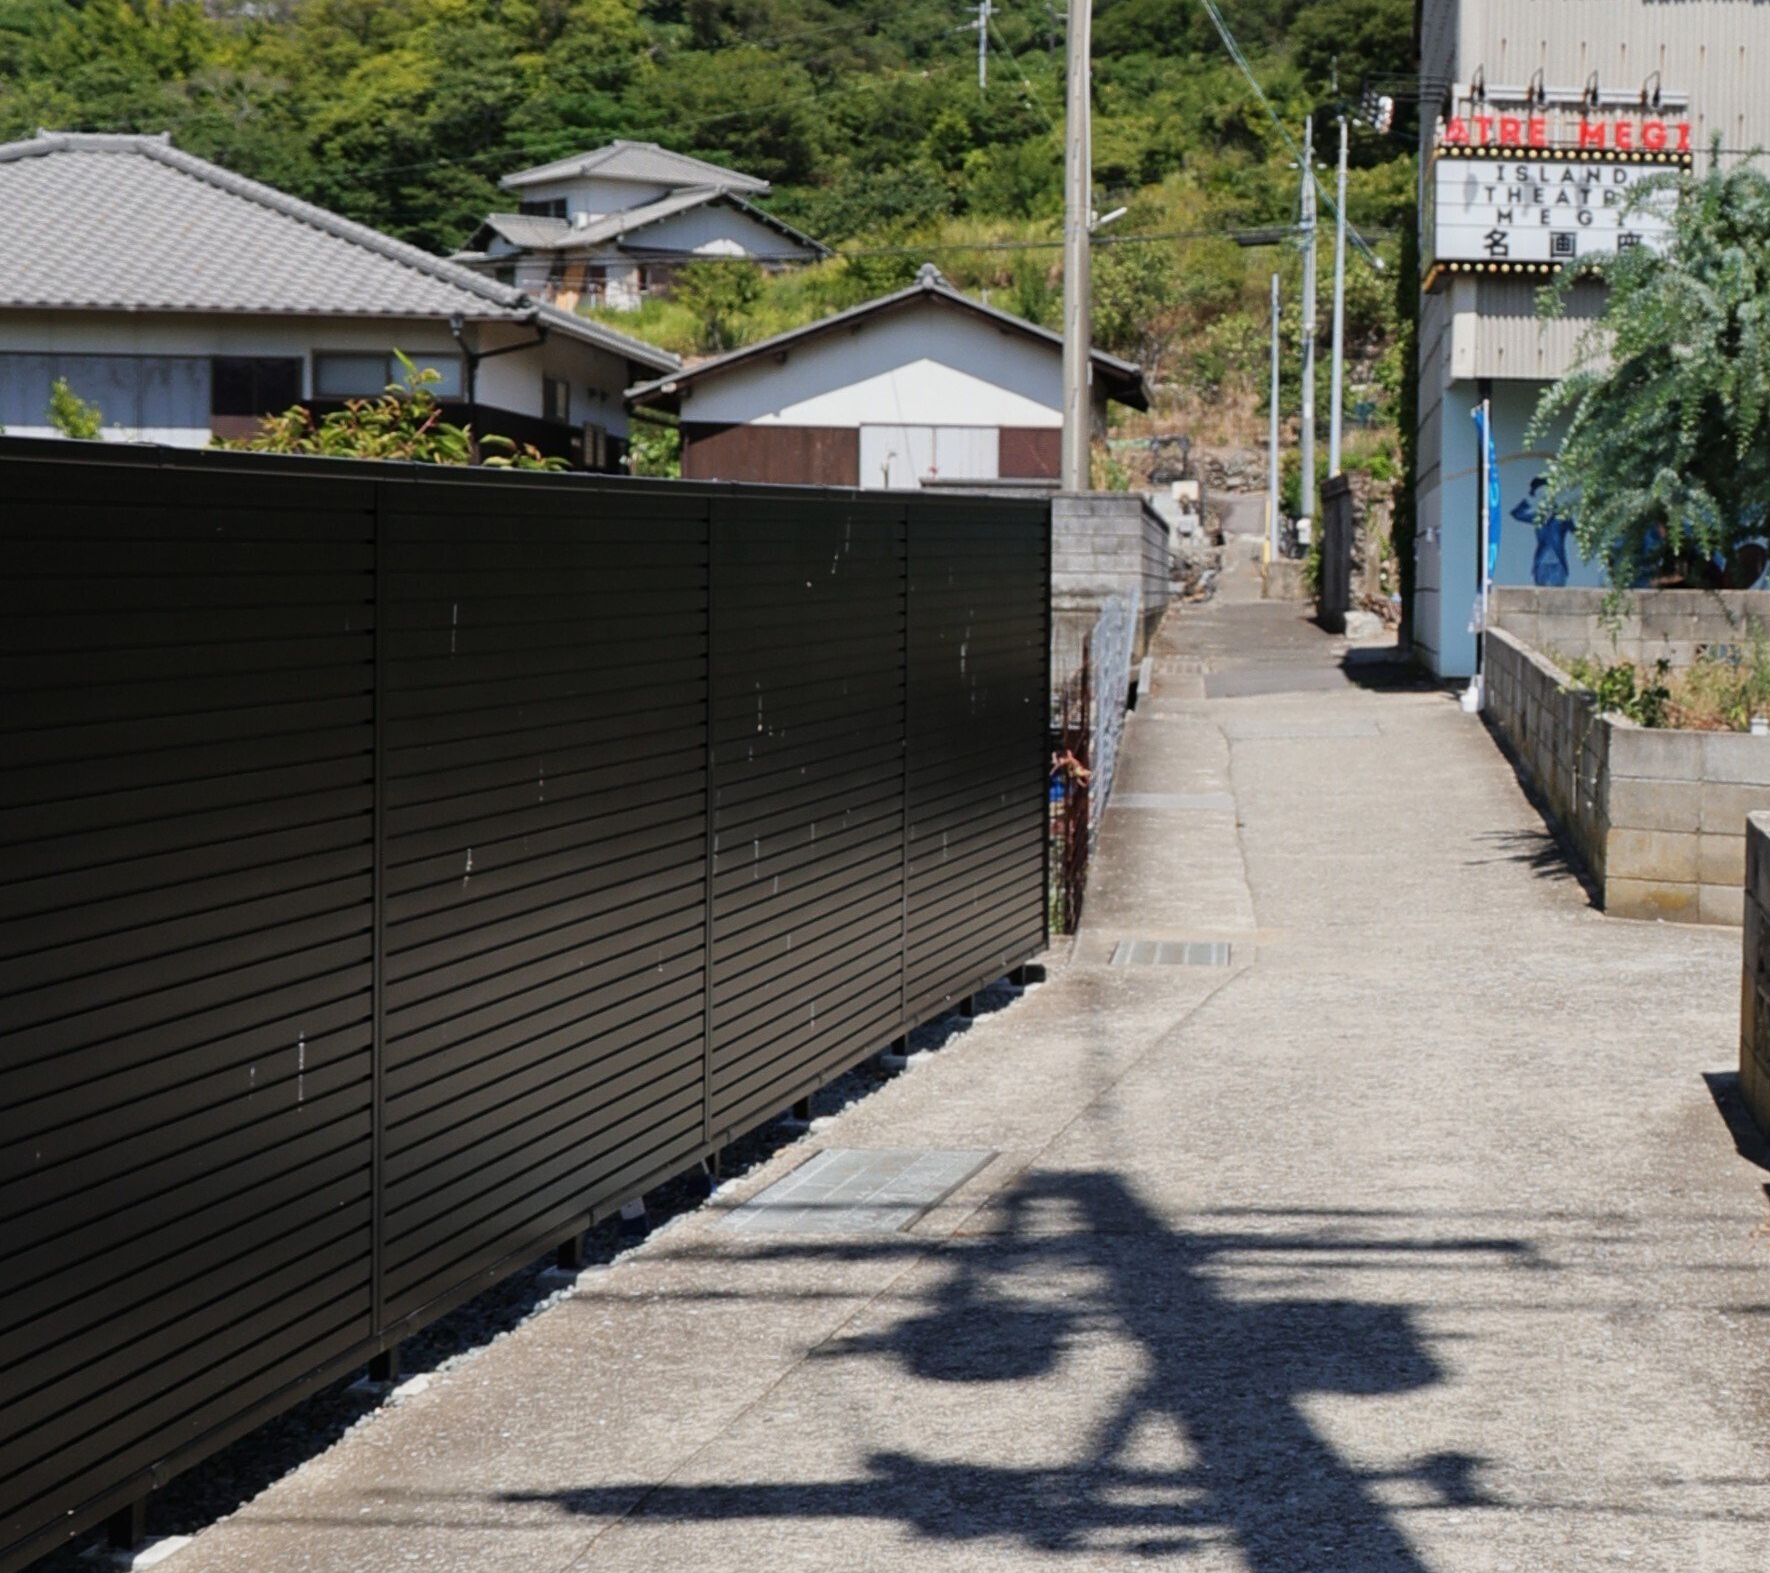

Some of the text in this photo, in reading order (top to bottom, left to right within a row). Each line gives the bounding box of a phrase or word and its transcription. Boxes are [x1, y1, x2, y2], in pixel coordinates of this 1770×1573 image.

[1579, 117, 1692, 151] MEGI
[1497, 165, 1628, 184] ISLAND
[1485, 186, 1640, 207] THEATR
